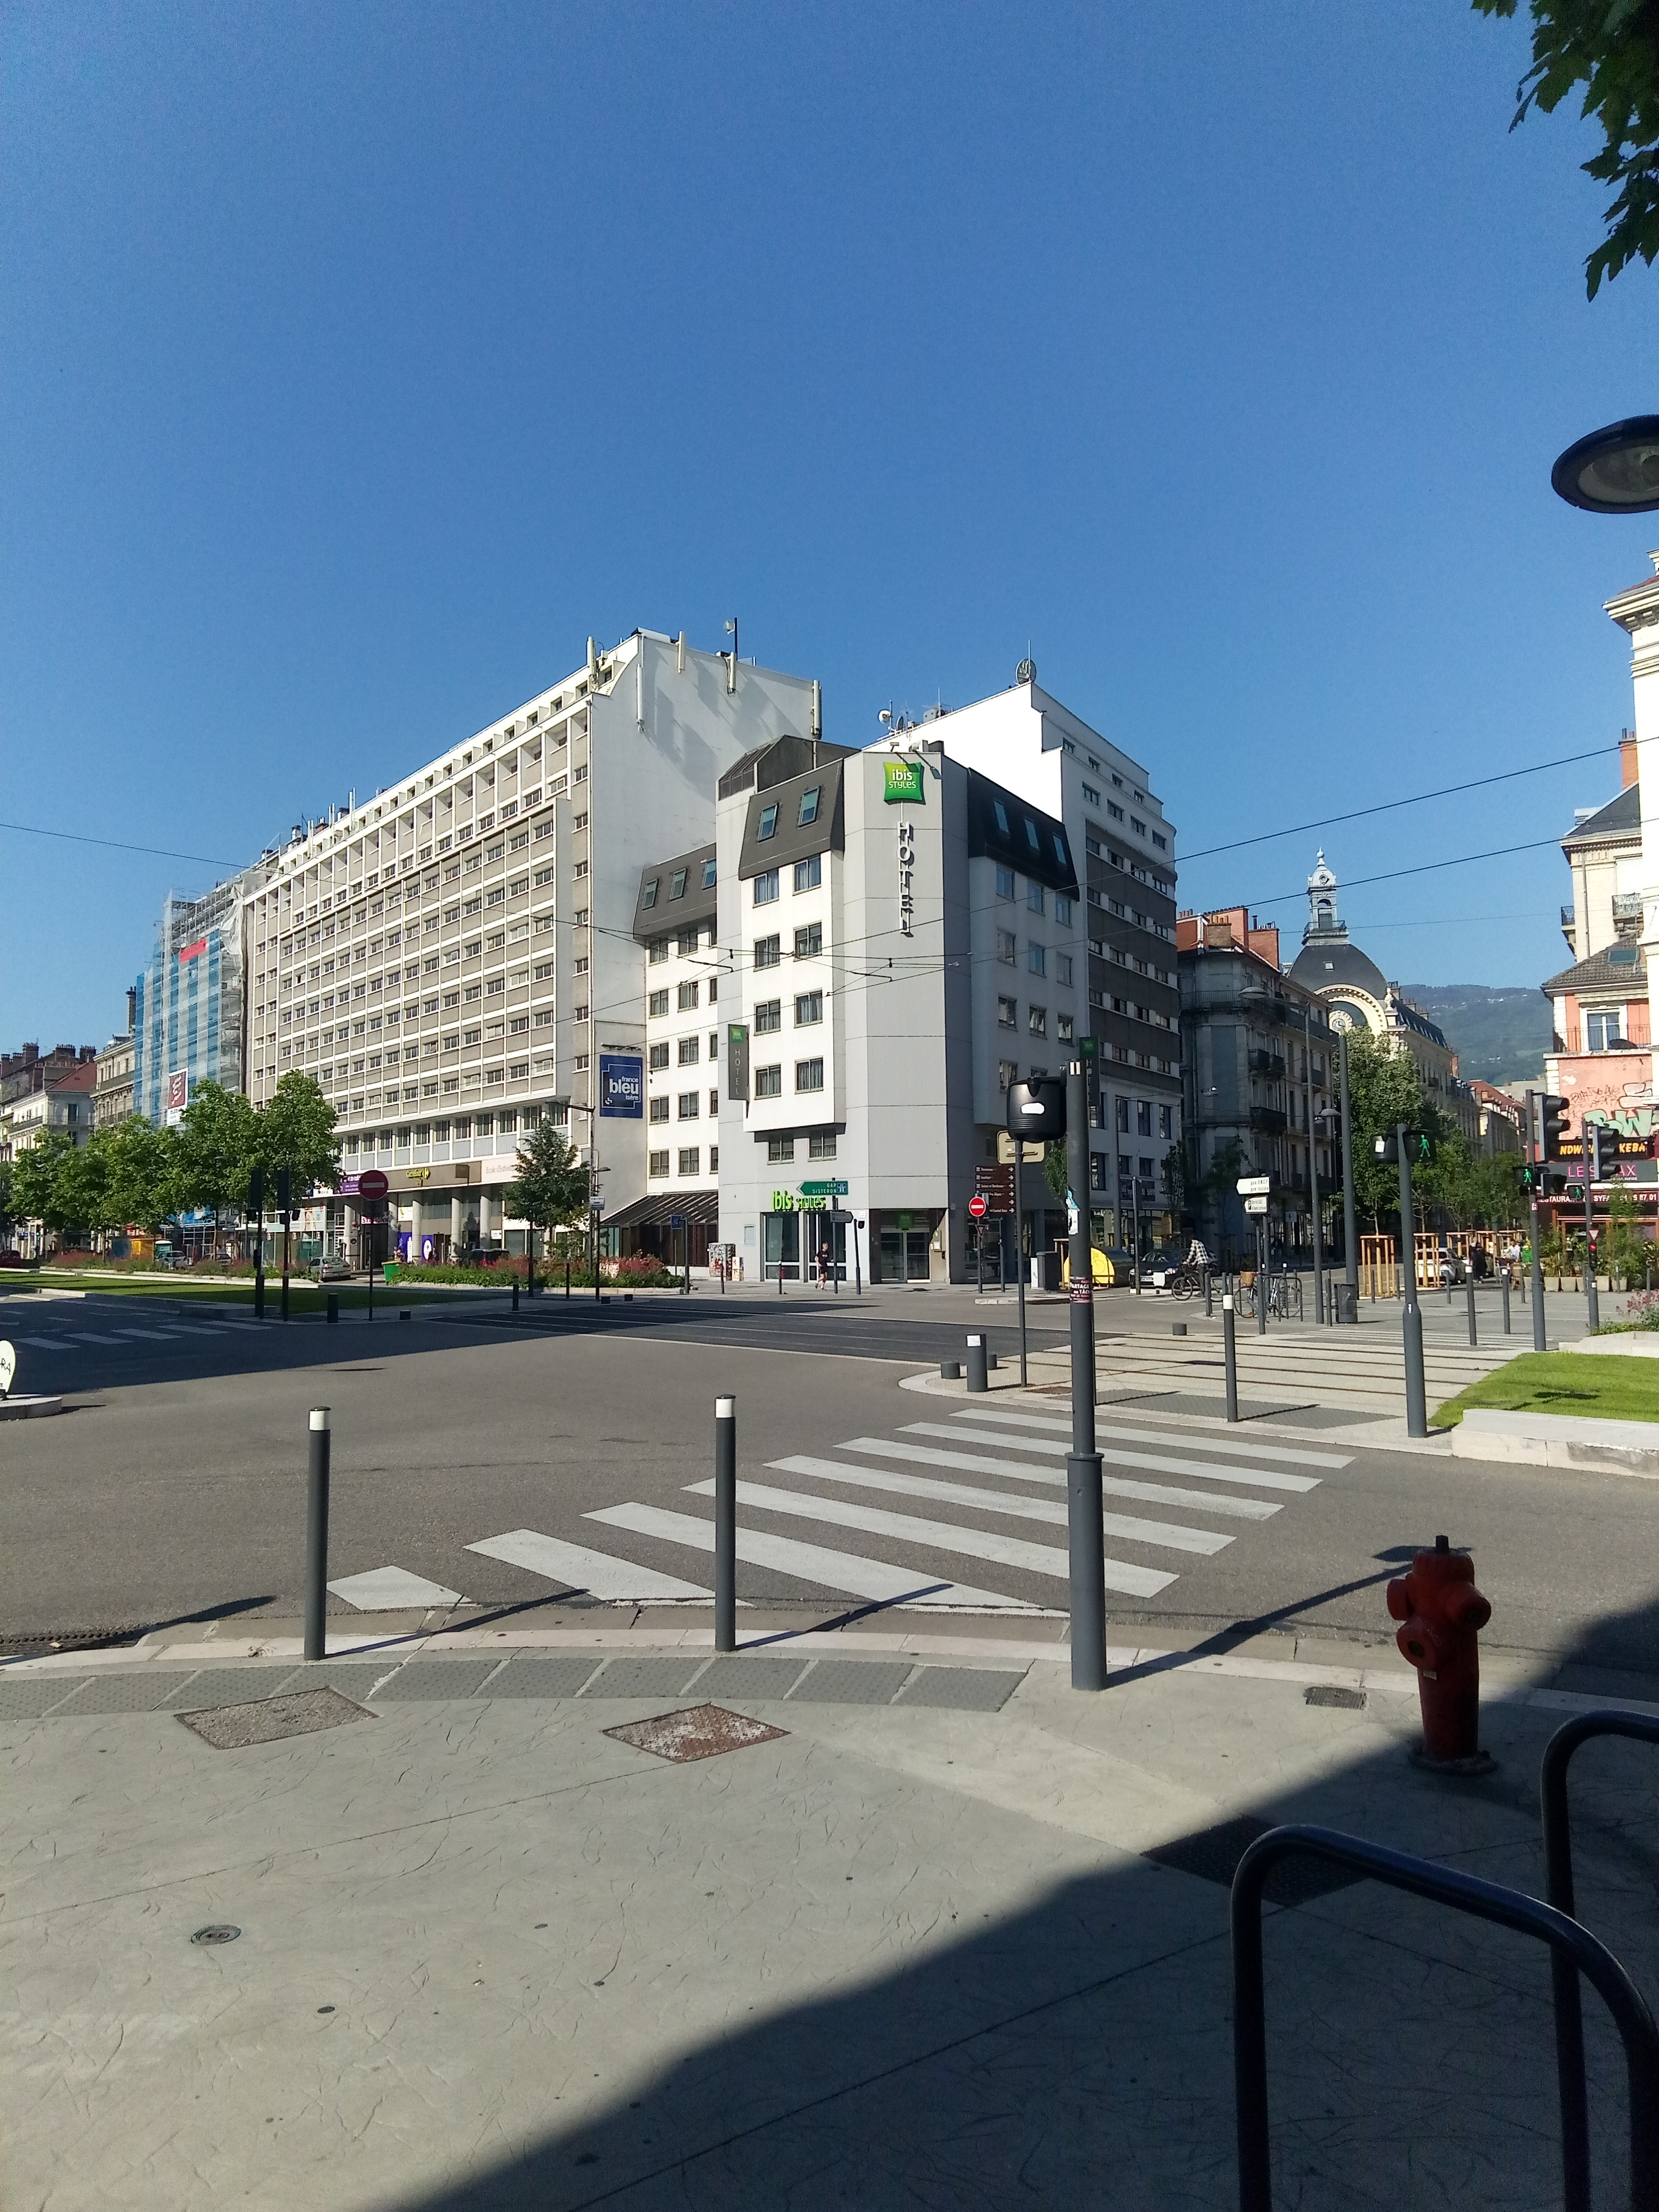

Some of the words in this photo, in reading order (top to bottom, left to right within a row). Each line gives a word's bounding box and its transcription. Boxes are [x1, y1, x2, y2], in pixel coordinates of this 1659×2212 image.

[892, 769, 913, 781] ibis
[898, 822, 911, 933] HOTEL
[609, 1078, 639, 1094] bleu
[1619, 1142, 1647, 1153] KEBA
[1568, 1166, 1584, 1177] LE
[773, 1191, 793, 1210] ibis
